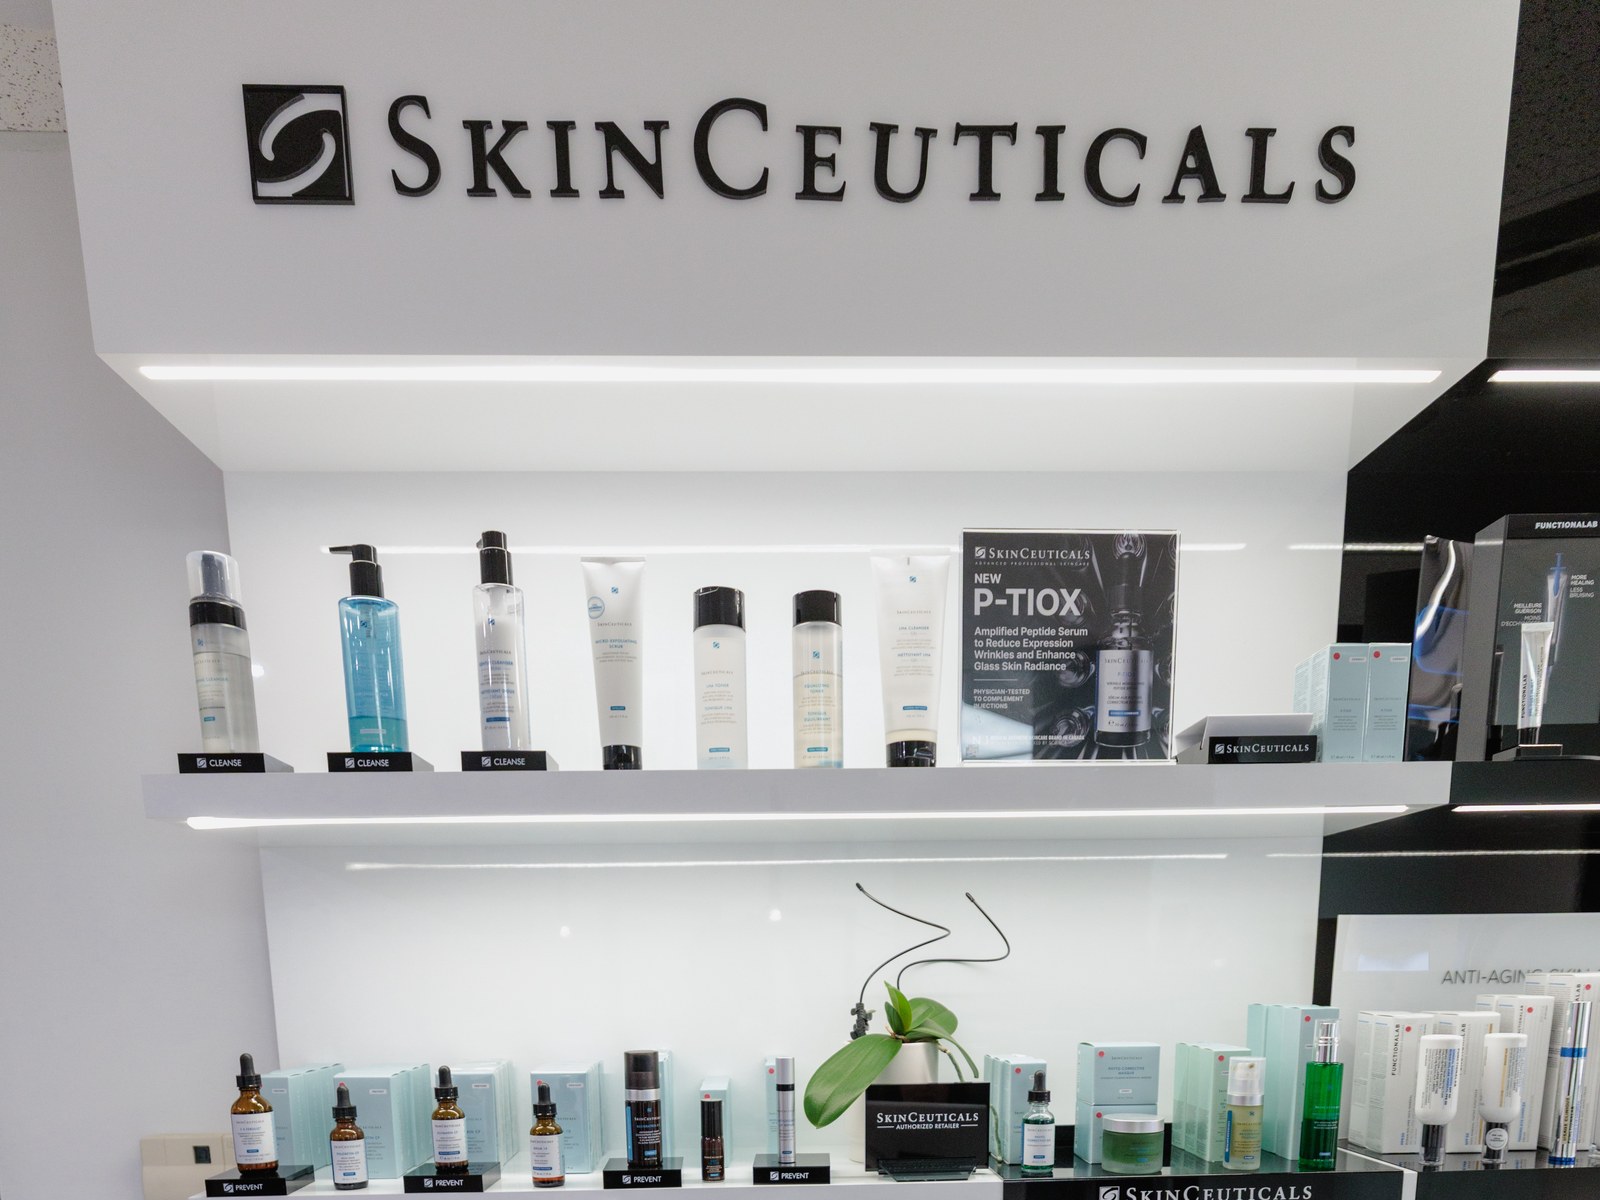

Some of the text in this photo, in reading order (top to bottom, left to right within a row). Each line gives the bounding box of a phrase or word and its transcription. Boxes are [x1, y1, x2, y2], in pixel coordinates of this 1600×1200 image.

[387, 94, 1357, 208] SKINCEUTICALS
[1535, 520, 1599, 530] FUNCTIONALAB
[988, 547, 1091, 560] SKINCEUTICALS
[974, 573, 1002, 584] NEW
[973, 587, 1082, 617] P-TIOX
[974, 626, 1089, 639] Amplified Peptide Serum
[974, 638, 1074, 650] to Reduce Expression
[974, 649, 1076, 660] Wrinkles and Enhance
[974, 661, 1067, 671] Glass Skin Radiance
[1226, 742, 1311, 755] SKINCEUTICALS
[208, 758, 242, 768] CLEANSE
[356, 758, 390, 768] CLEANSE
[493, 757, 526, 766] CLEANSE
[1441, 969, 1543, 985] ANTI-AGIN
[1391, 1023, 1401, 1076] FUNCTIONALAB
[876, 1111, 979, 1124] SKINCEUTICALS
[633, 1175, 662, 1183] PREVENT
[781, 1171, 810, 1180] PREVENT
[235, 1183, 263, 1191] PREVENT
[435, 1179, 464, 1187] PREVENT
